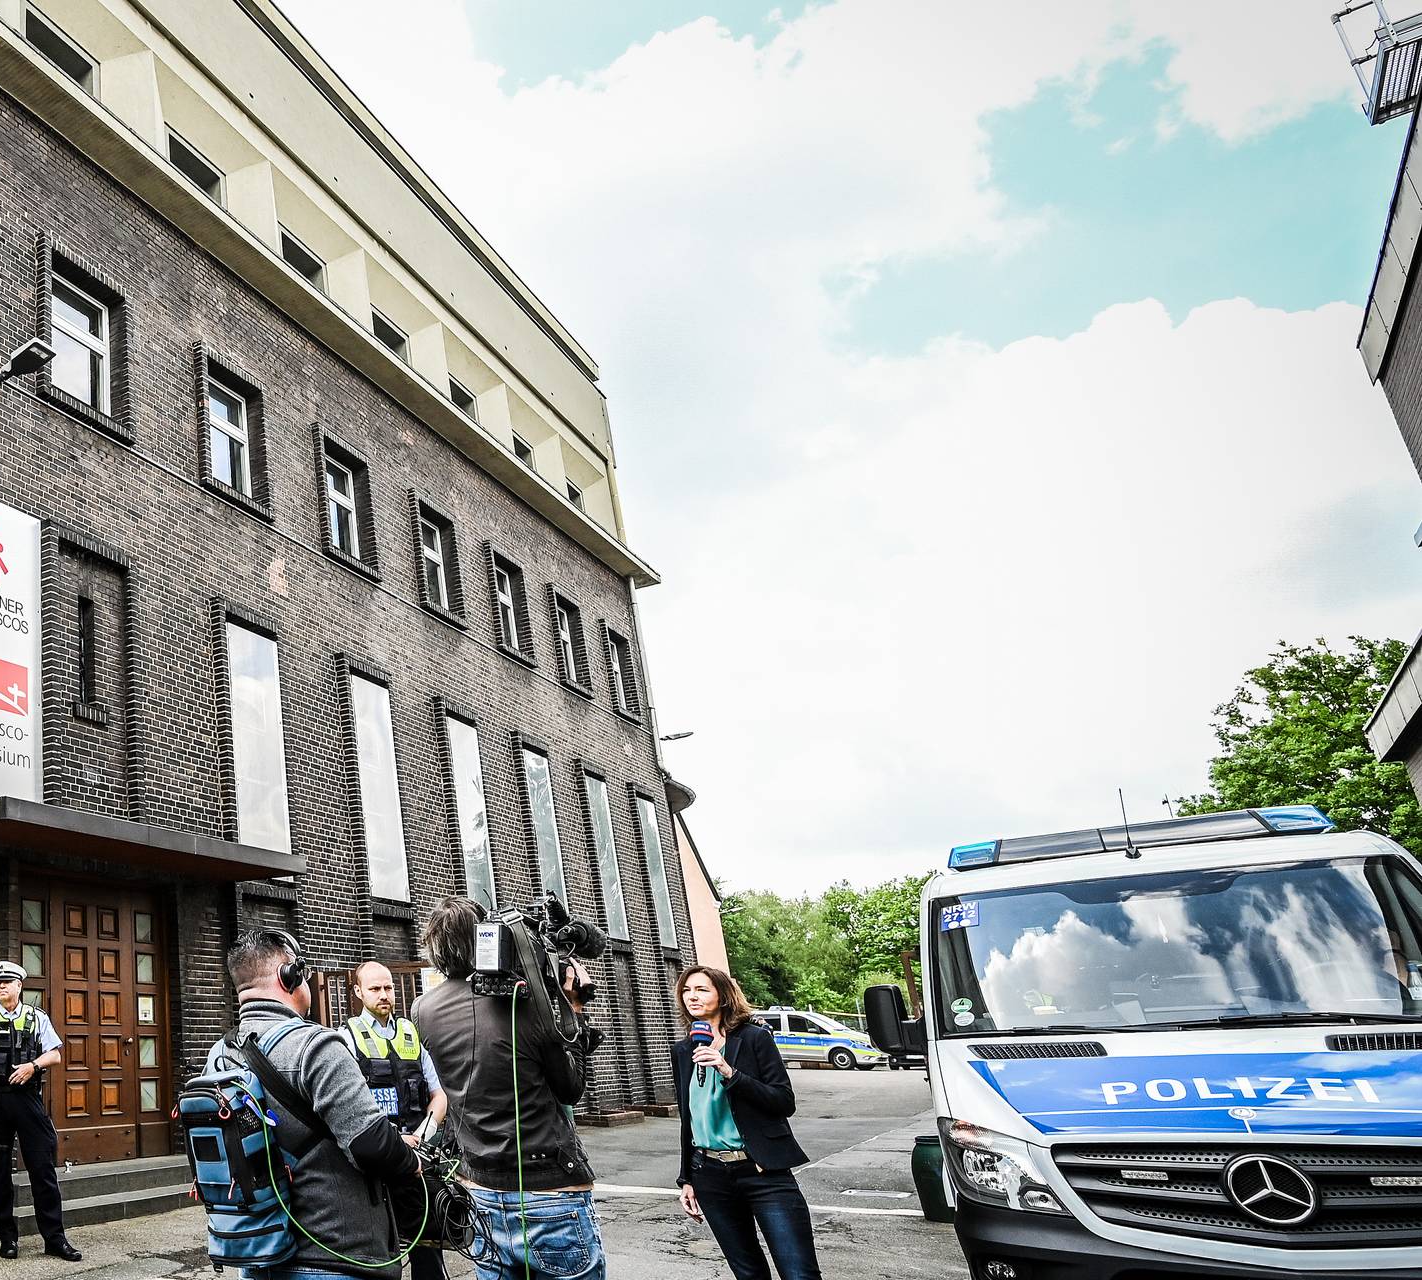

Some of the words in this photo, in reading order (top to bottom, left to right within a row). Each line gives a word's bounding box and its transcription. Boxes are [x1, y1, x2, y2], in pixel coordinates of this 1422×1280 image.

[942, 901, 976, 915] NRW
[943, 910, 976, 923] 2712
[370, 1088, 396, 1101] ESSE
[1100, 1077, 1380, 1105] POLIZEI
